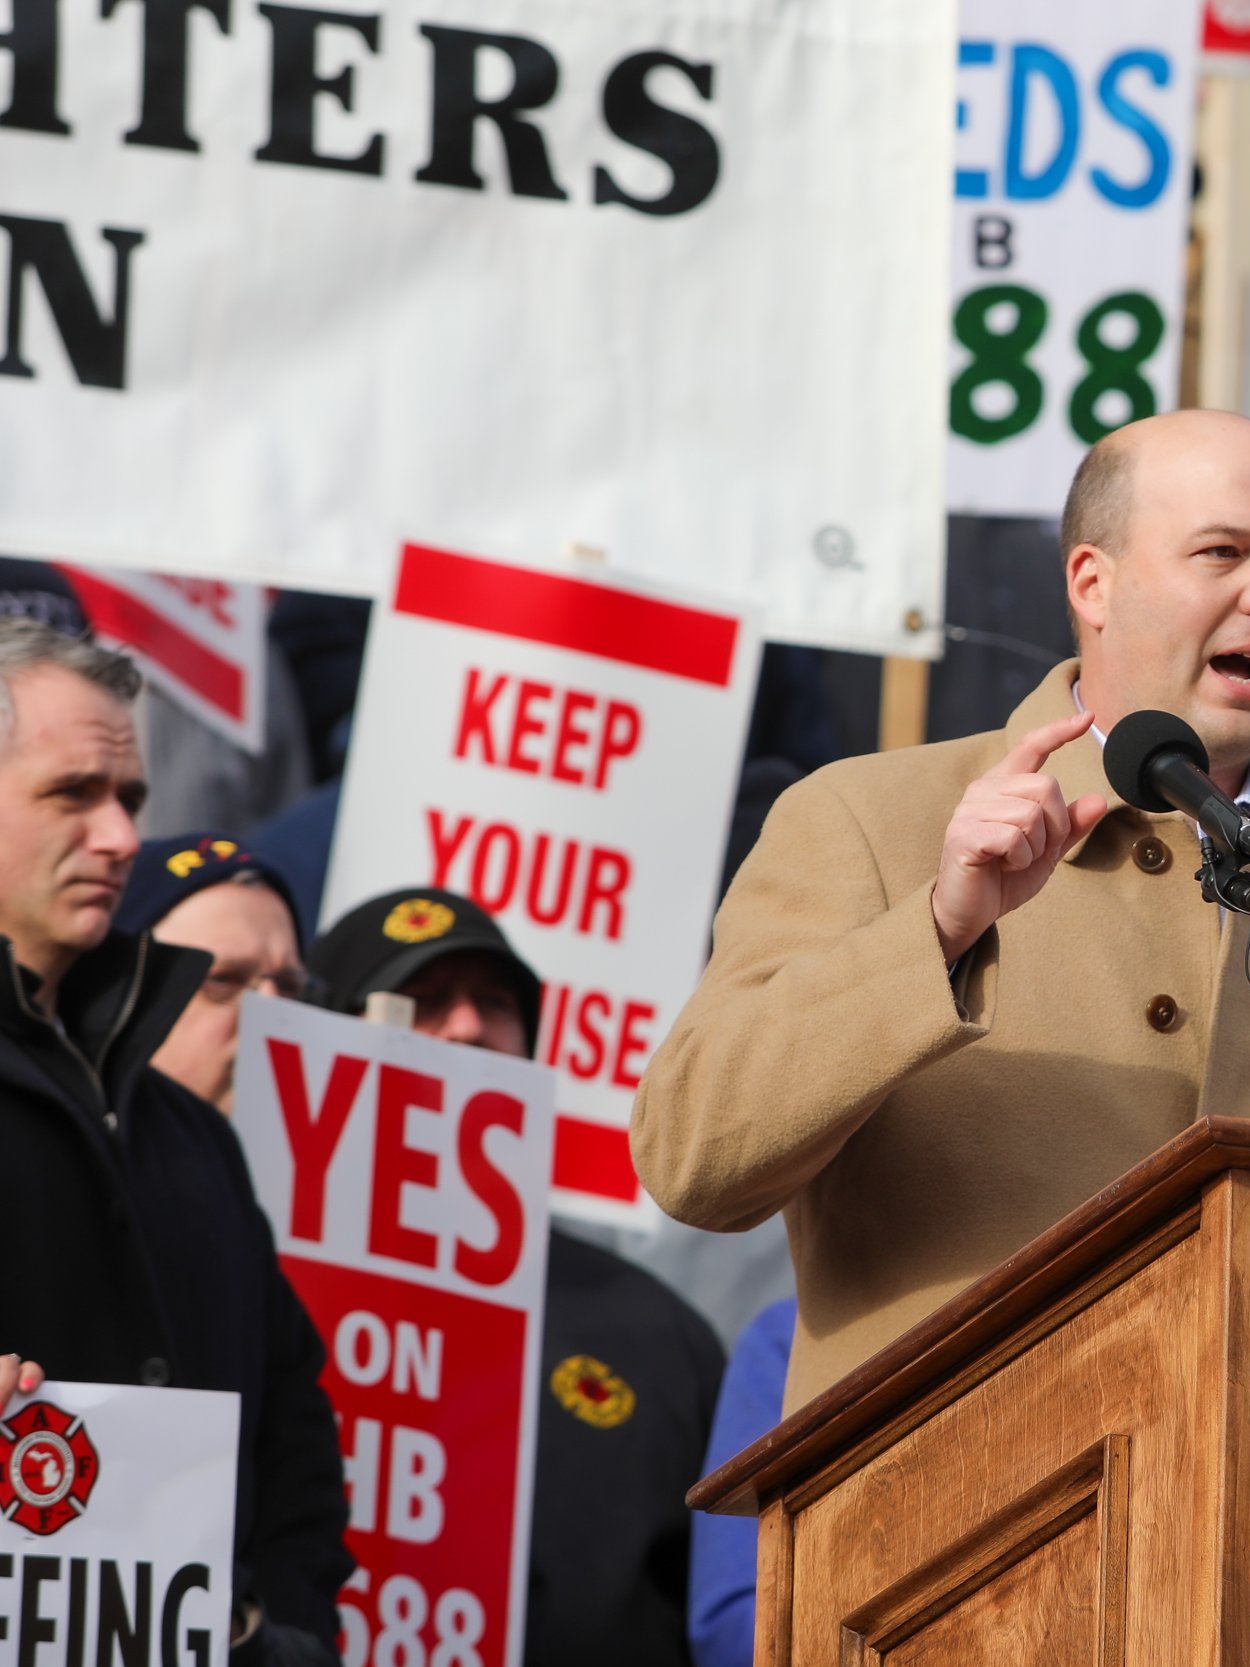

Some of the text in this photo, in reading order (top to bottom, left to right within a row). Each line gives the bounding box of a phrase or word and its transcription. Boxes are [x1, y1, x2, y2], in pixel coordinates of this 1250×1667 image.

[452, 668, 643, 791] KEEP
[424, 807, 632, 942] YOUR
[540, 980, 655, 1091] ISE
[267, 1036, 527, 1288] YES
[334, 1309, 443, 1401] ON
